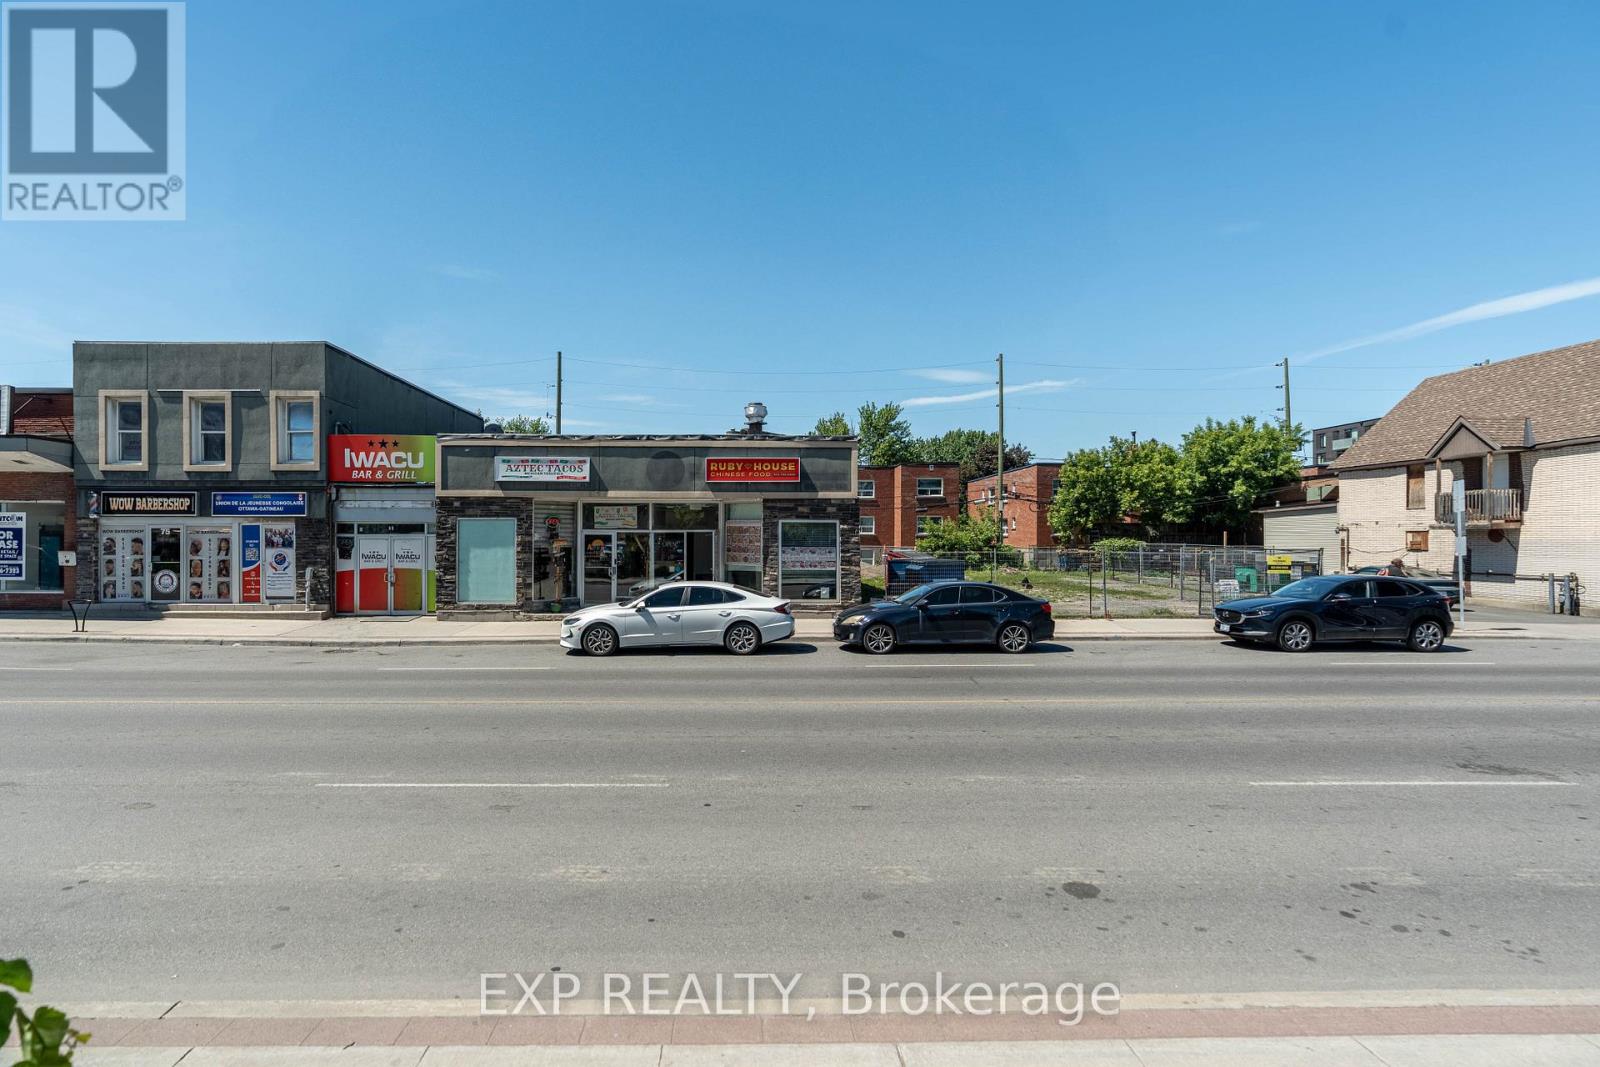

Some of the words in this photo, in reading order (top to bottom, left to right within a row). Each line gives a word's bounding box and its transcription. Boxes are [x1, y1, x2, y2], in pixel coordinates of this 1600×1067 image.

[344, 447, 425, 469] IWACU
[505, 464, 544, 473] AZTEC
[545, 464, 584, 473] TACOS
[710, 462, 744, 471] RUBY
[753, 462, 796, 471] HOUSE
[351, 470, 372, 479] BAR
[375, 470, 384, 479] &
[386, 470, 417, 479] GRILL
[108, 497, 135, 511] WOW
[135, 497, 191, 511] BARBERSHOP
